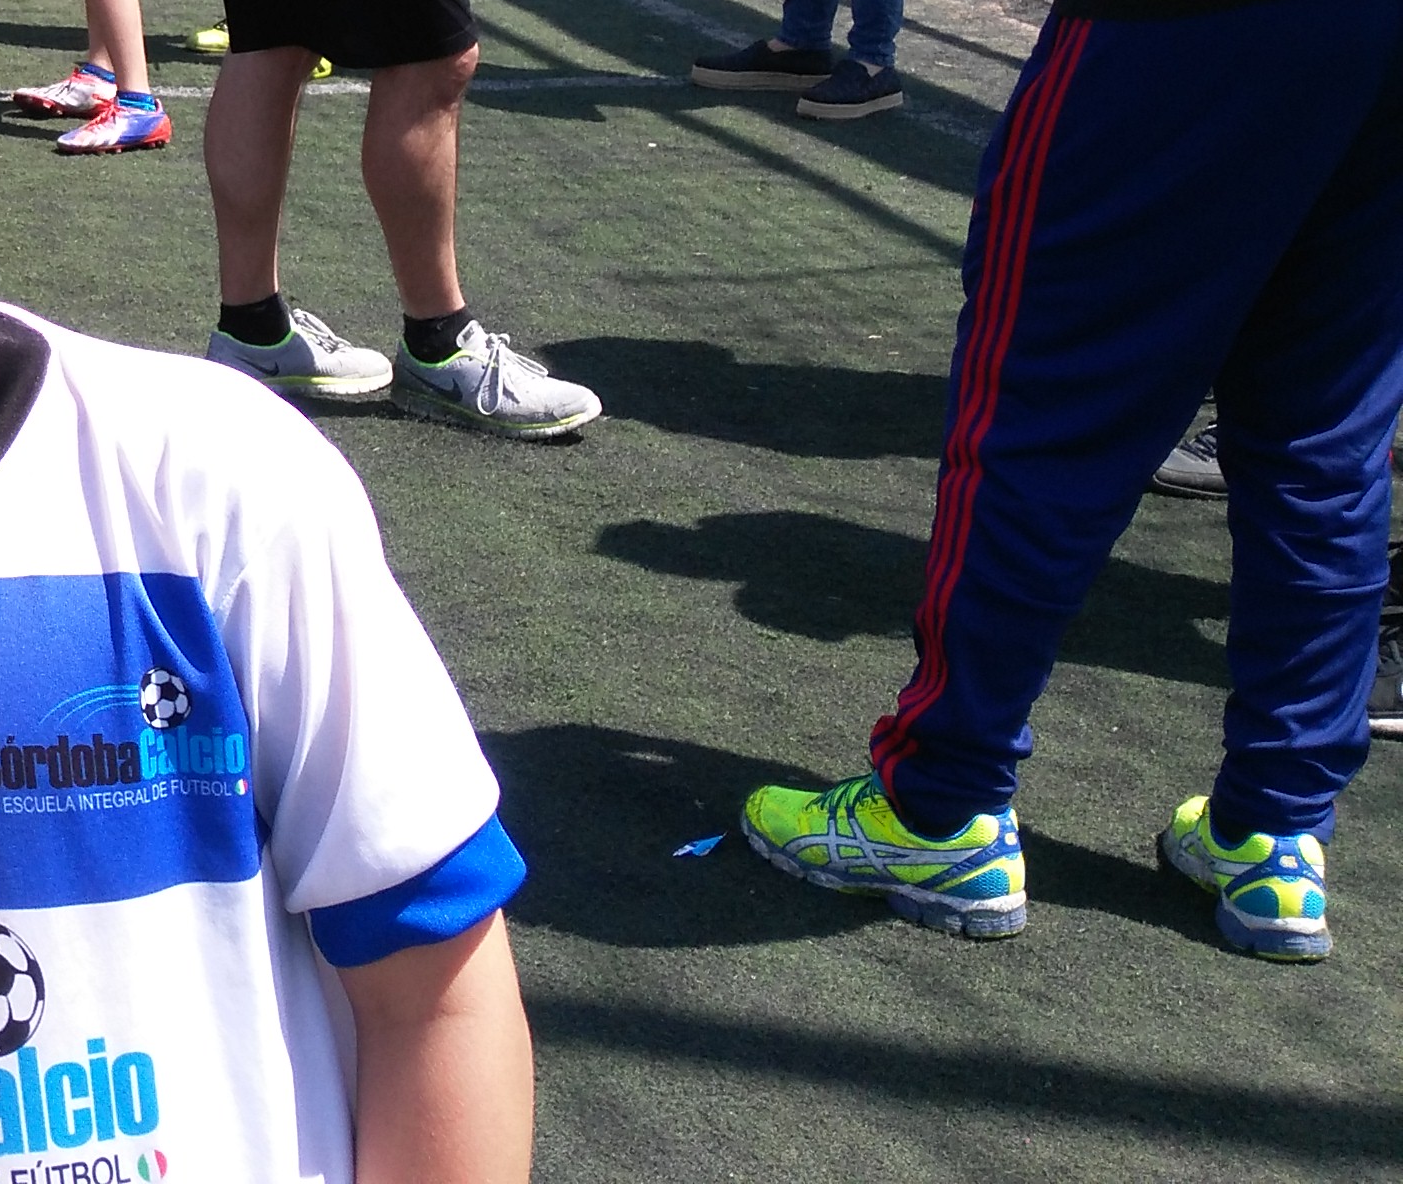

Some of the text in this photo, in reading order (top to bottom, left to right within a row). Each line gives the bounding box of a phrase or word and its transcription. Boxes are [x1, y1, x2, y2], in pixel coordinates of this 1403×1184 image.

[2, 795, 76, 814] ESCUELA
[79, 787, 150, 811] INTEGRAL
[152, 781, 168, 800] DE
